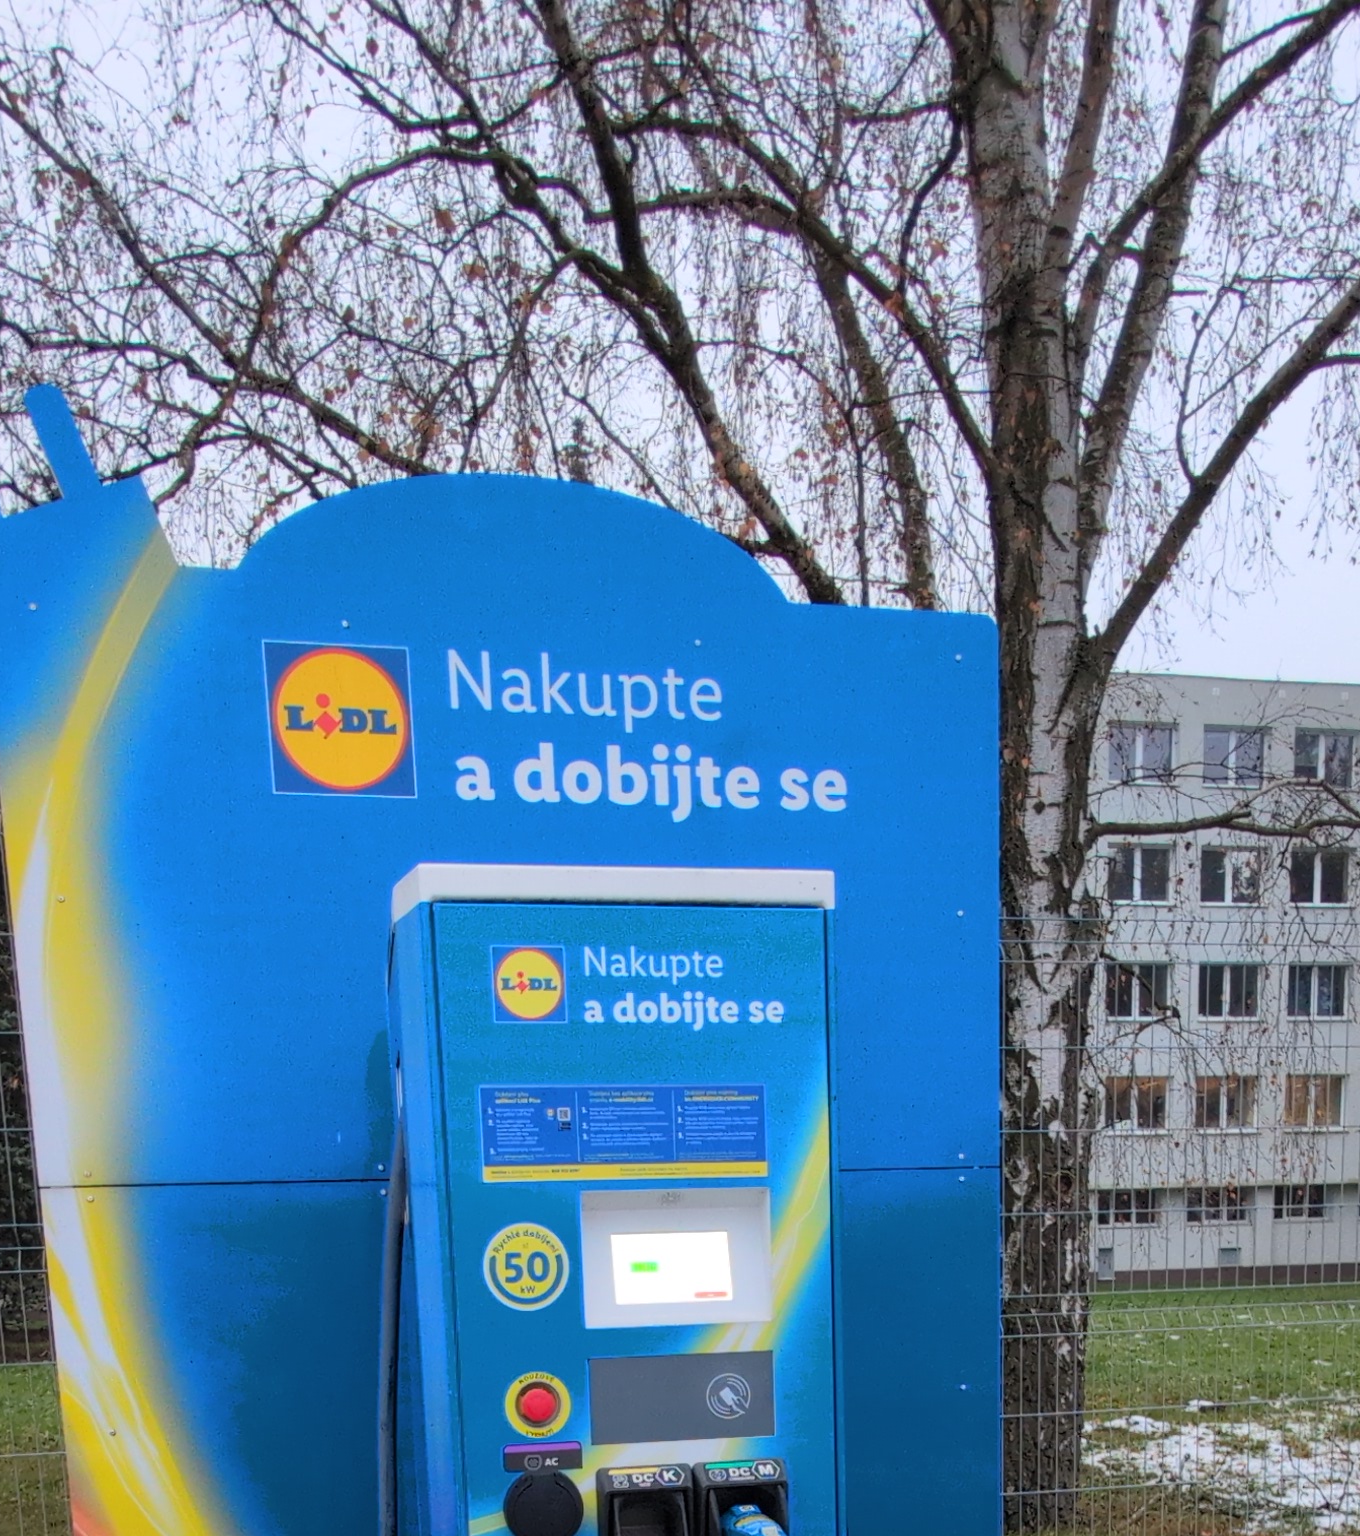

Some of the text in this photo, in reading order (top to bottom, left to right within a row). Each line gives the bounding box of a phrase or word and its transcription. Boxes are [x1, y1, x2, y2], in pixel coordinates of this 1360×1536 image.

[446, 648, 723, 734] Nakupte
[455, 743, 848, 823] a dobijte se
[583, 946, 724, 985] Nakupte
[583, 991, 785, 1031] a dobijte se
[505, 1251, 550, 1283] 50
[520, 1285, 535, 1293] kW
[544, 1457, 559, 1466] AC
[632, 1470, 676, 1484] DC K
[729, 1464, 774, 1477] DC M
